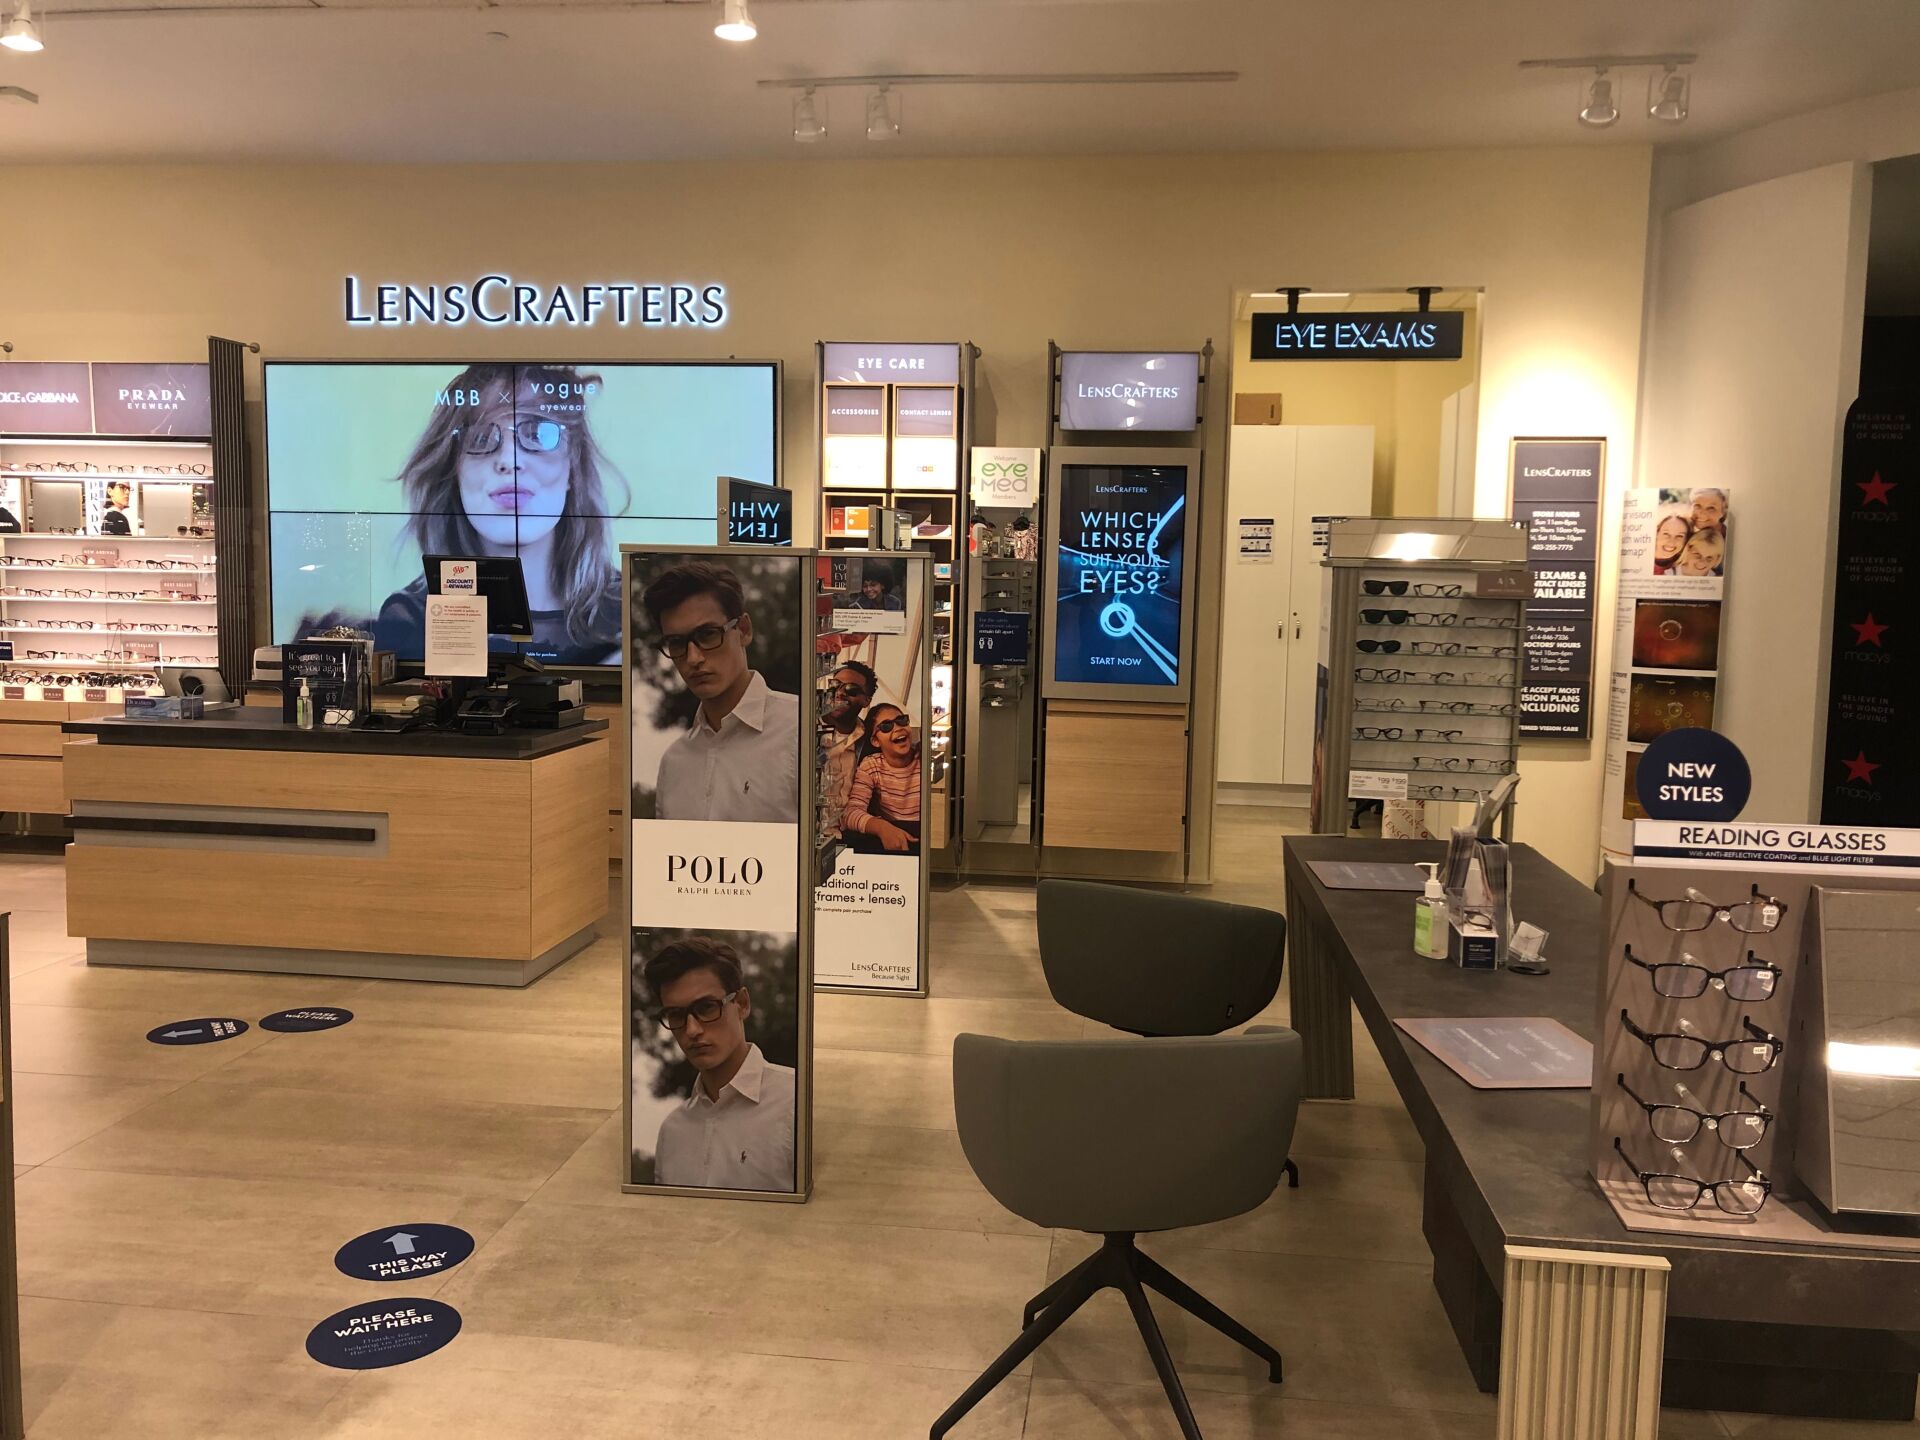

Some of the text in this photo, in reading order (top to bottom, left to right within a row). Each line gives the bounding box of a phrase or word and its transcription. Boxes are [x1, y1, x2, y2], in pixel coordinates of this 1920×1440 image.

[344, 275, 725, 324] LENSCRAFTERS
[1275, 321, 1438, 348] EYE EXAMS
[857, 357, 925, 369] EYE CARE
[118, 389, 186, 401] PRADA
[434, 382, 597, 406] MBB vogue
[1078, 383, 1179, 398] LENSCRAFTERS
[127, 402, 178, 410] EYEWEAR
[539, 403, 588, 413] eyewear
[831, 408, 879, 416] ACCESSORIES
[1524, 466, 1592, 477] LENSCRAFTERS
[1096, 485, 1148, 493] LENSCRAFTERS
[1080, 511, 1161, 529] WHICH
[1080, 554, 1113, 566] SUIT
[1540, 571, 1576, 580] EXAMS
[1578, 571, 1587, 580] &
[1080, 570, 1160, 594] EYES?
[1534, 588, 1586, 599] AILABLE
[303, 653, 323, 662] great
[1090, 656, 1142, 666] START NOW
[304, 665, 320, 674] you
[1520, 703, 1580, 713] NCLUDING
[1668, 762, 1716, 779] NEW
[1659, 784, 1724, 803] STYLES
[1679, 826, 1886, 851] READING GLASSES
[1705, 851, 1762, 860] ANTI-REFLECTIVE
[1764, 853, 1796, 861] COATING
[666, 854, 763, 885] POLO
[839, 865, 855, 876] off
[677, 886, 752, 896] RALPH LAUREN
[871, 881, 900, 892] pairs
[868, 894, 906, 908] lenses)
[851, 962, 911, 973] LENSCRAFTERS
[896, 974, 910, 982] Sight
[368, 1251, 448, 1271] THIS WAY
[380, 1260, 443, 1277] PLEASE
[350, 1308, 416, 1327] PLEASE
[334, 1314, 434, 1338] WAIT HERE
